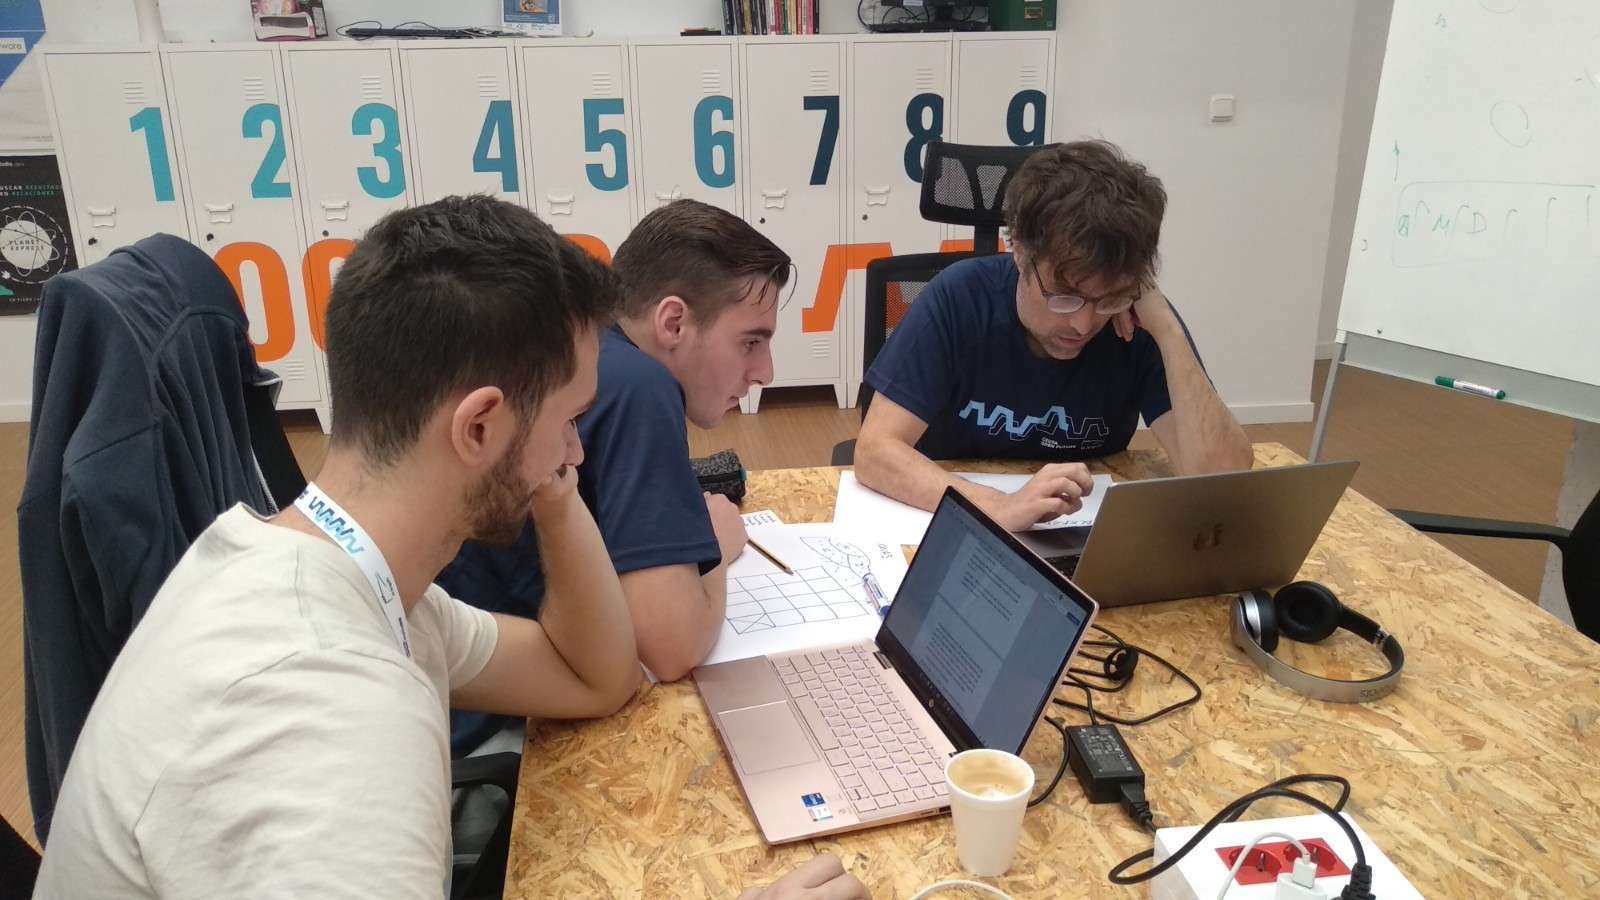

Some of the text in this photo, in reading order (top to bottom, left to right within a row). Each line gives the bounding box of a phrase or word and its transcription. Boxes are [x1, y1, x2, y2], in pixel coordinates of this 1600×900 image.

[130, 107, 175, 202] 1
[242, 103, 292, 199] 2
[350, 103, 406, 199] 3
[473, 100, 519, 192] 4
[583, 98, 629, 191] 5
[693, 95, 735, 188] 6
[803, 95, 840, 185] 7
[904, 92, 944, 183] 8
[1006, 89, 1047, 146] 9
